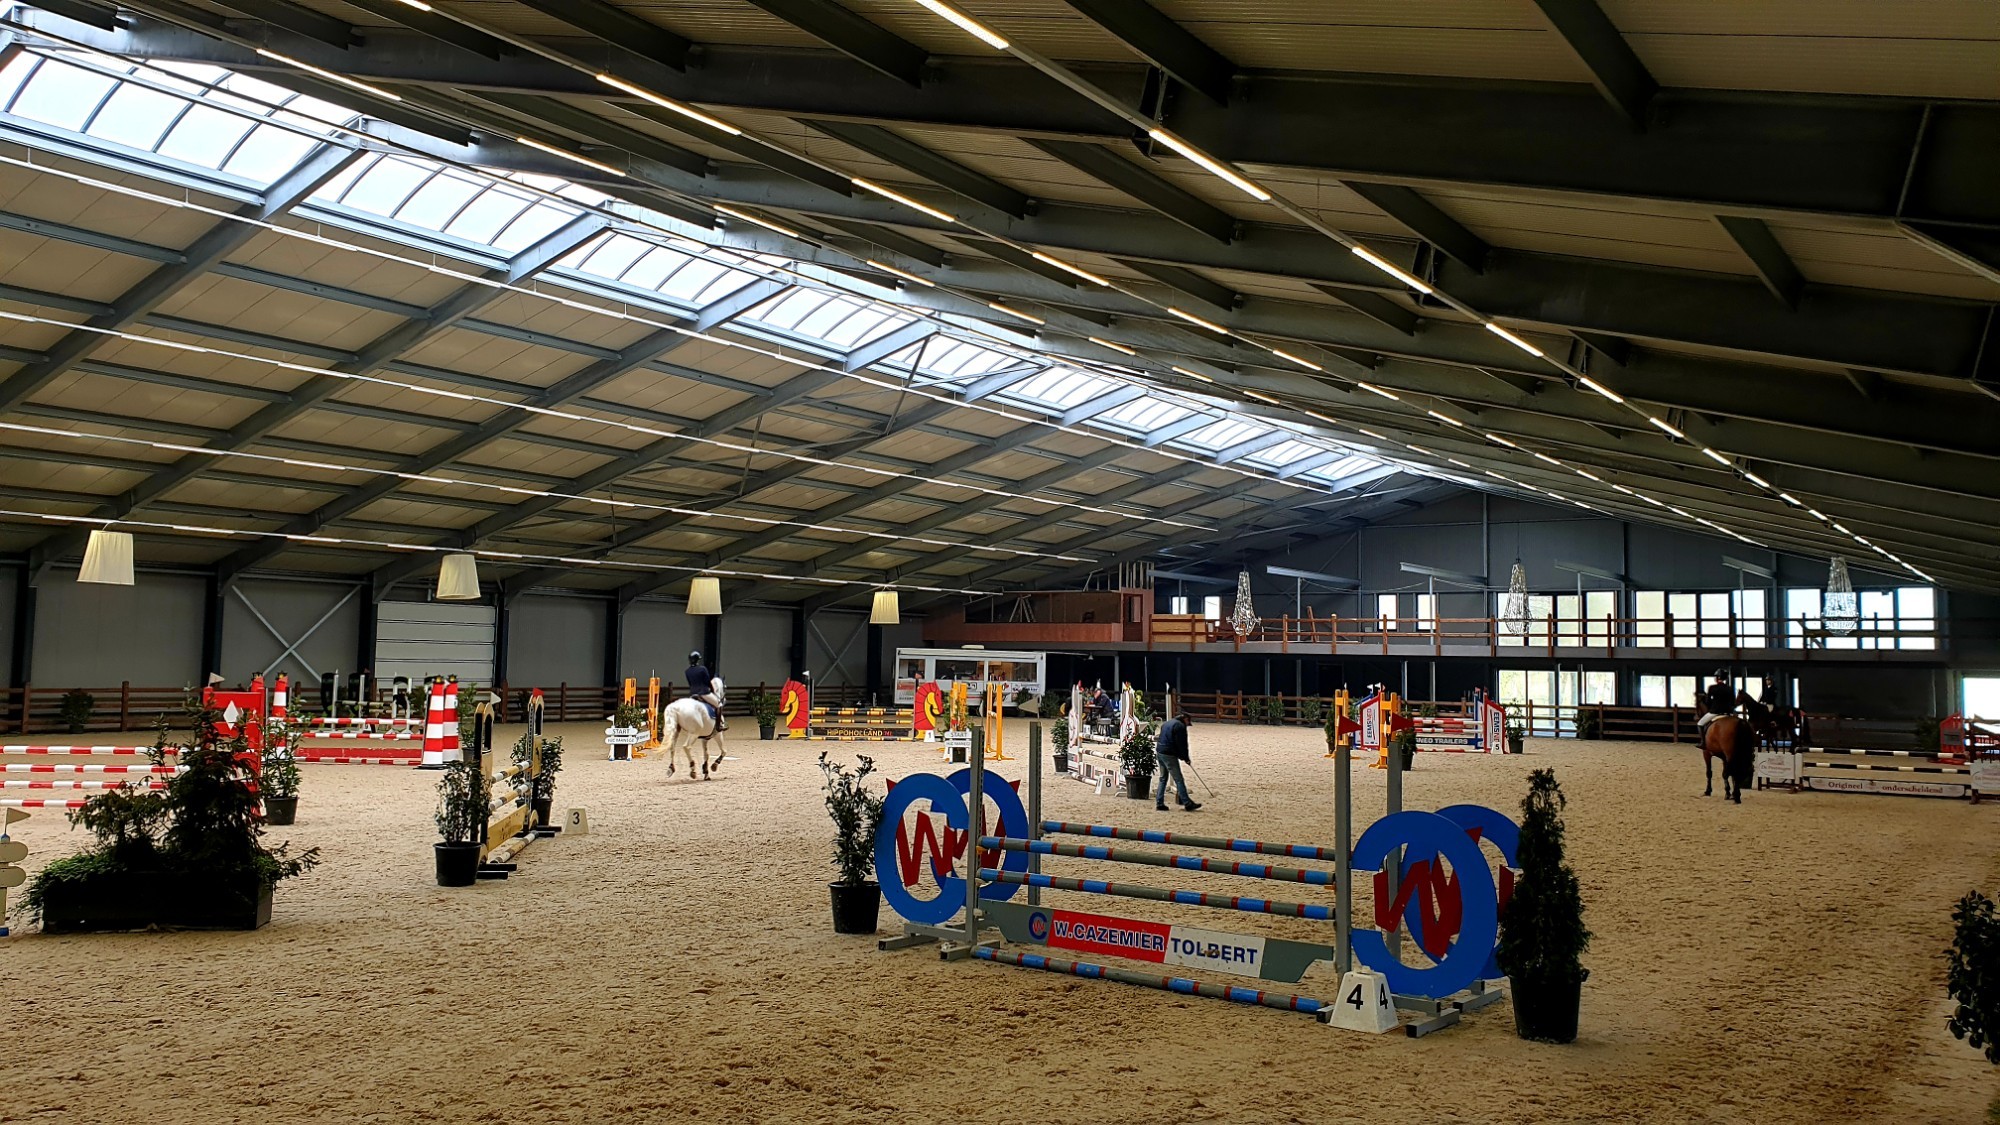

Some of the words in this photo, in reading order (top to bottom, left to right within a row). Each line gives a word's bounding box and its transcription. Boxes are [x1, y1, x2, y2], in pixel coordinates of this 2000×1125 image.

[1495, 743, 1500, 751] 5
[1105, 777, 1112, 788] 8
[1828, 781, 1863, 790] Origineel
[572, 811, 580, 825] 3
[1053, 920, 1165, 951] W.CAZEMIER
[1171, 937, 1258, 964] TOLBERT
[1346, 983, 1364, 1011] 4
[1379, 983, 1389, 1010] 4
